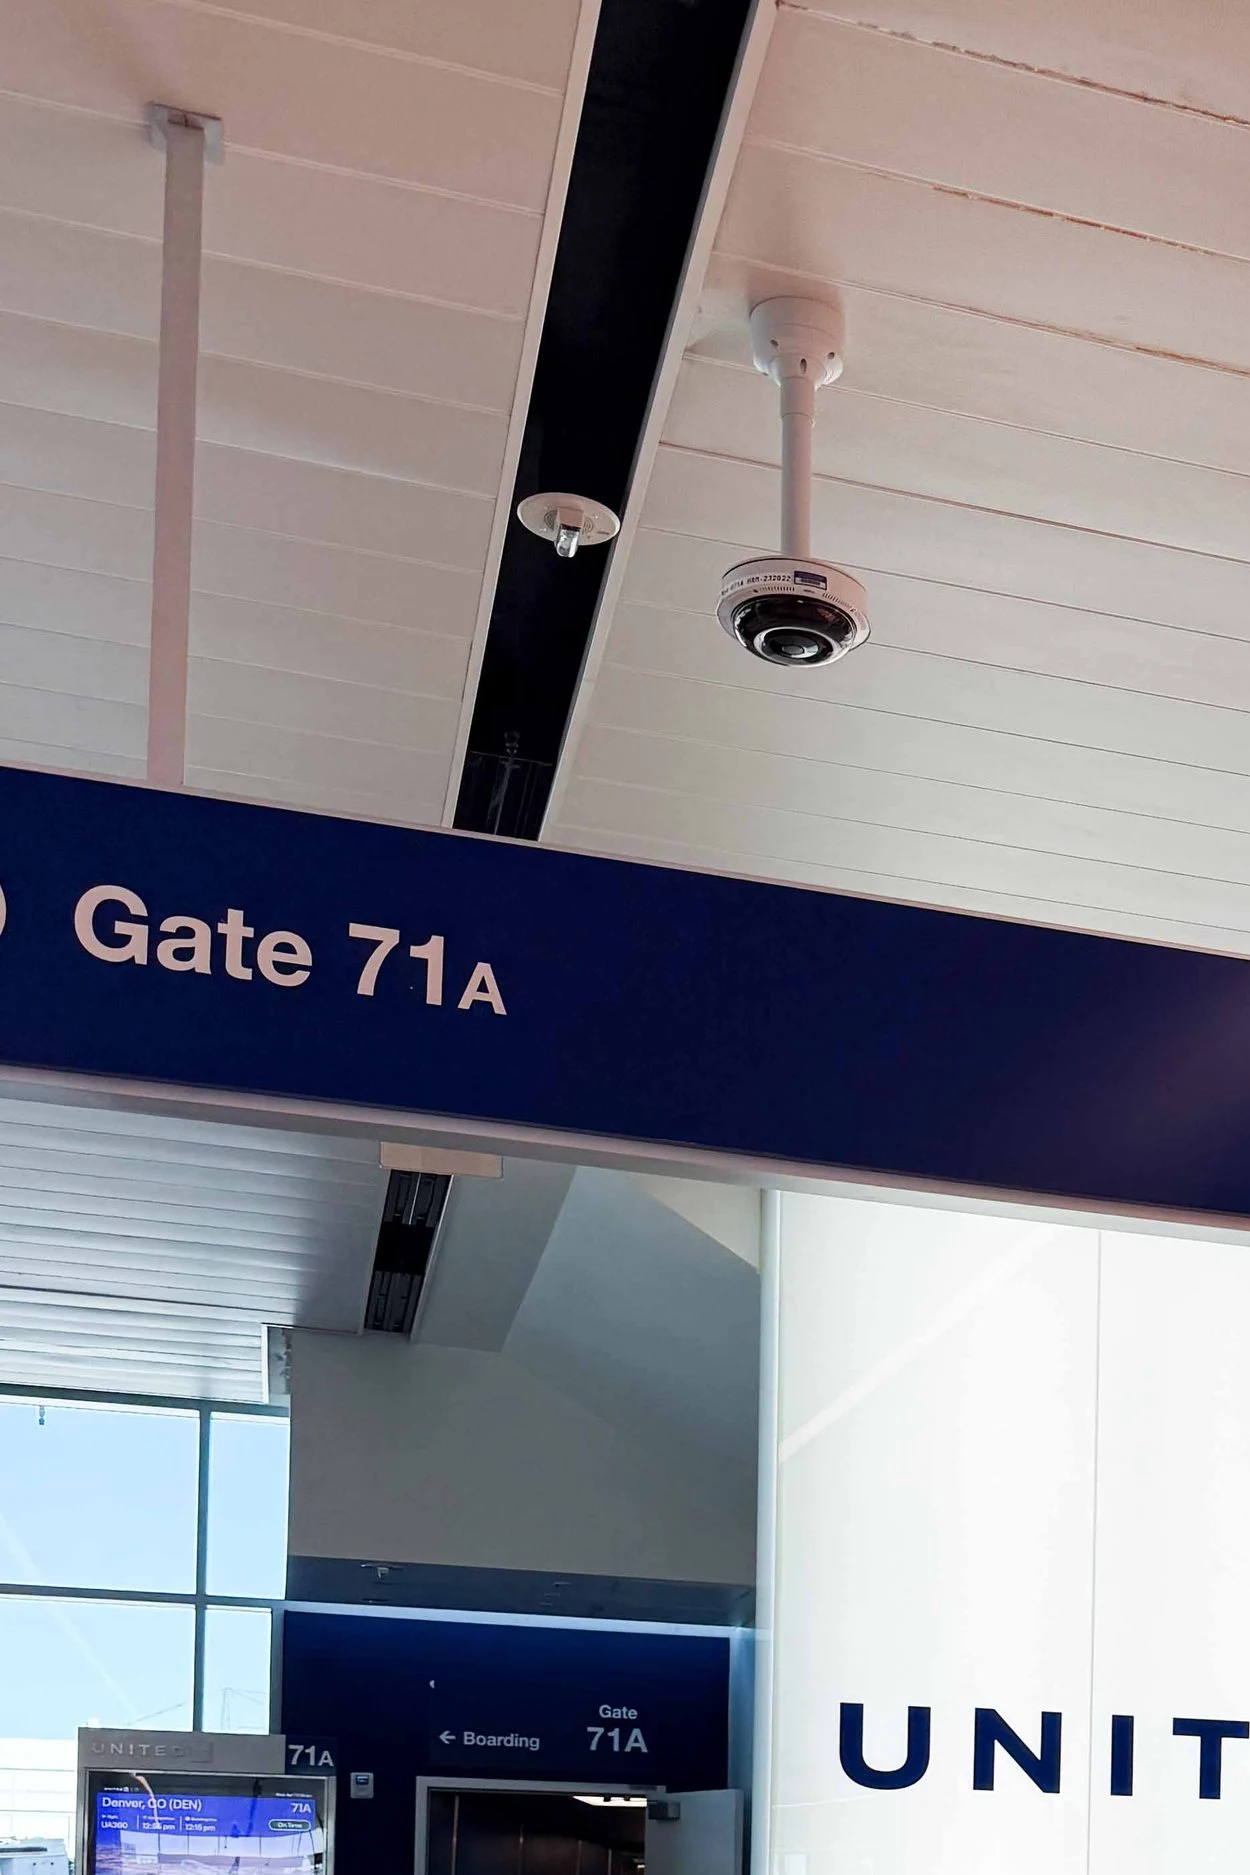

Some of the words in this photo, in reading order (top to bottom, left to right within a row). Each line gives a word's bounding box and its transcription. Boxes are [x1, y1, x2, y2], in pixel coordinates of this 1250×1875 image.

[74, 884, 313, 987] Gate
[348, 922, 507, 1016] 71A
[599, 1704, 639, 1719] Gate
[463, 1731, 541, 1751] Boarding
[586, 1726, 649, 1753] 71A
[91, 1743, 186, 1758] UNITED
[288, 1744, 334, 1767] 71A
[102, 1797, 146, 1810] Denver,
[169, 1798, 202, 1812] (DEN)
